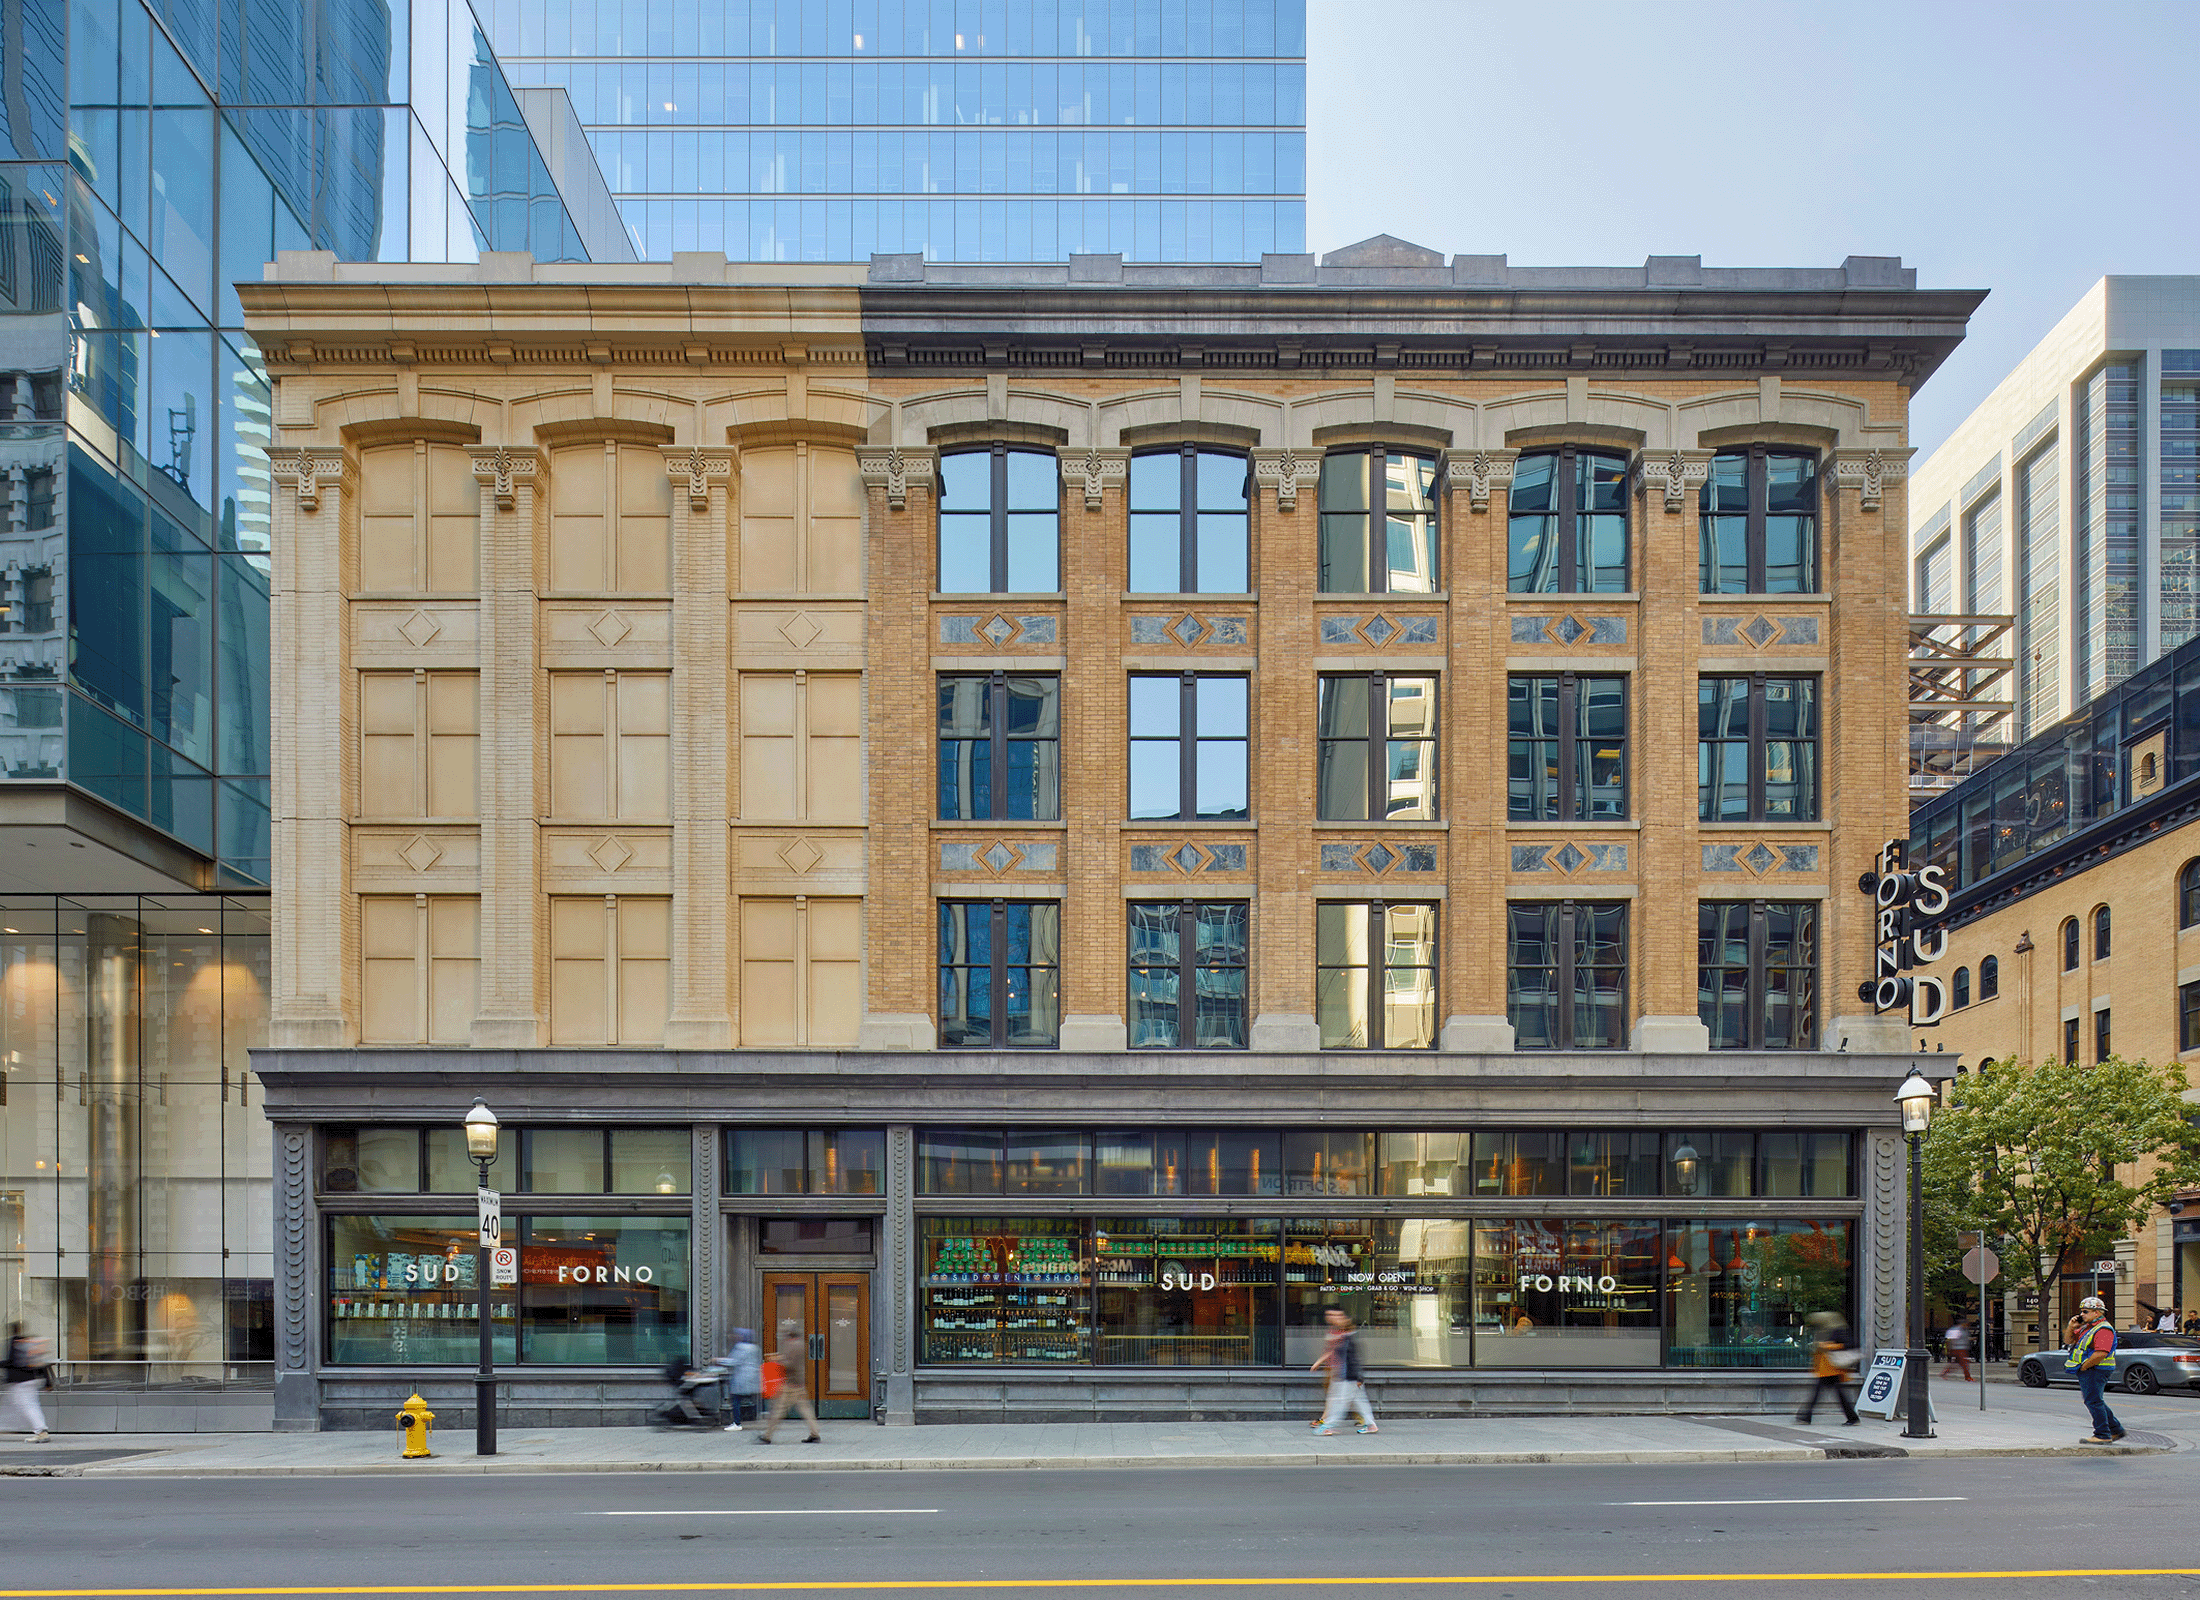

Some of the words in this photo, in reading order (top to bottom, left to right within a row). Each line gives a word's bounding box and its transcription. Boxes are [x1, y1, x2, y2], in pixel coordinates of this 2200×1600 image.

[1876, 838, 1900, 1010] FORNO
[1912, 865, 1949, 1024] SUD
[480, 1196, 499, 1206] MAXIMUM
[482, 1214, 499, 1240] 40
[405, 1264, 459, 1282] SUD
[558, 1265, 653, 1283] FORNO
[952, 1274, 979, 1283] SUD
[992, 1274, 1031, 1283] WINE
[1045, 1274, 1079, 1283] SHOP
[1161, 1273, 1215, 1291] SUD
[1348, 1272, 1375, 1283] NOW
[1378, 1272, 1406, 1283] OPEN
[1520, 1275, 1616, 1293] FORNO
[1879, 1356, 1896, 1365] SUD
